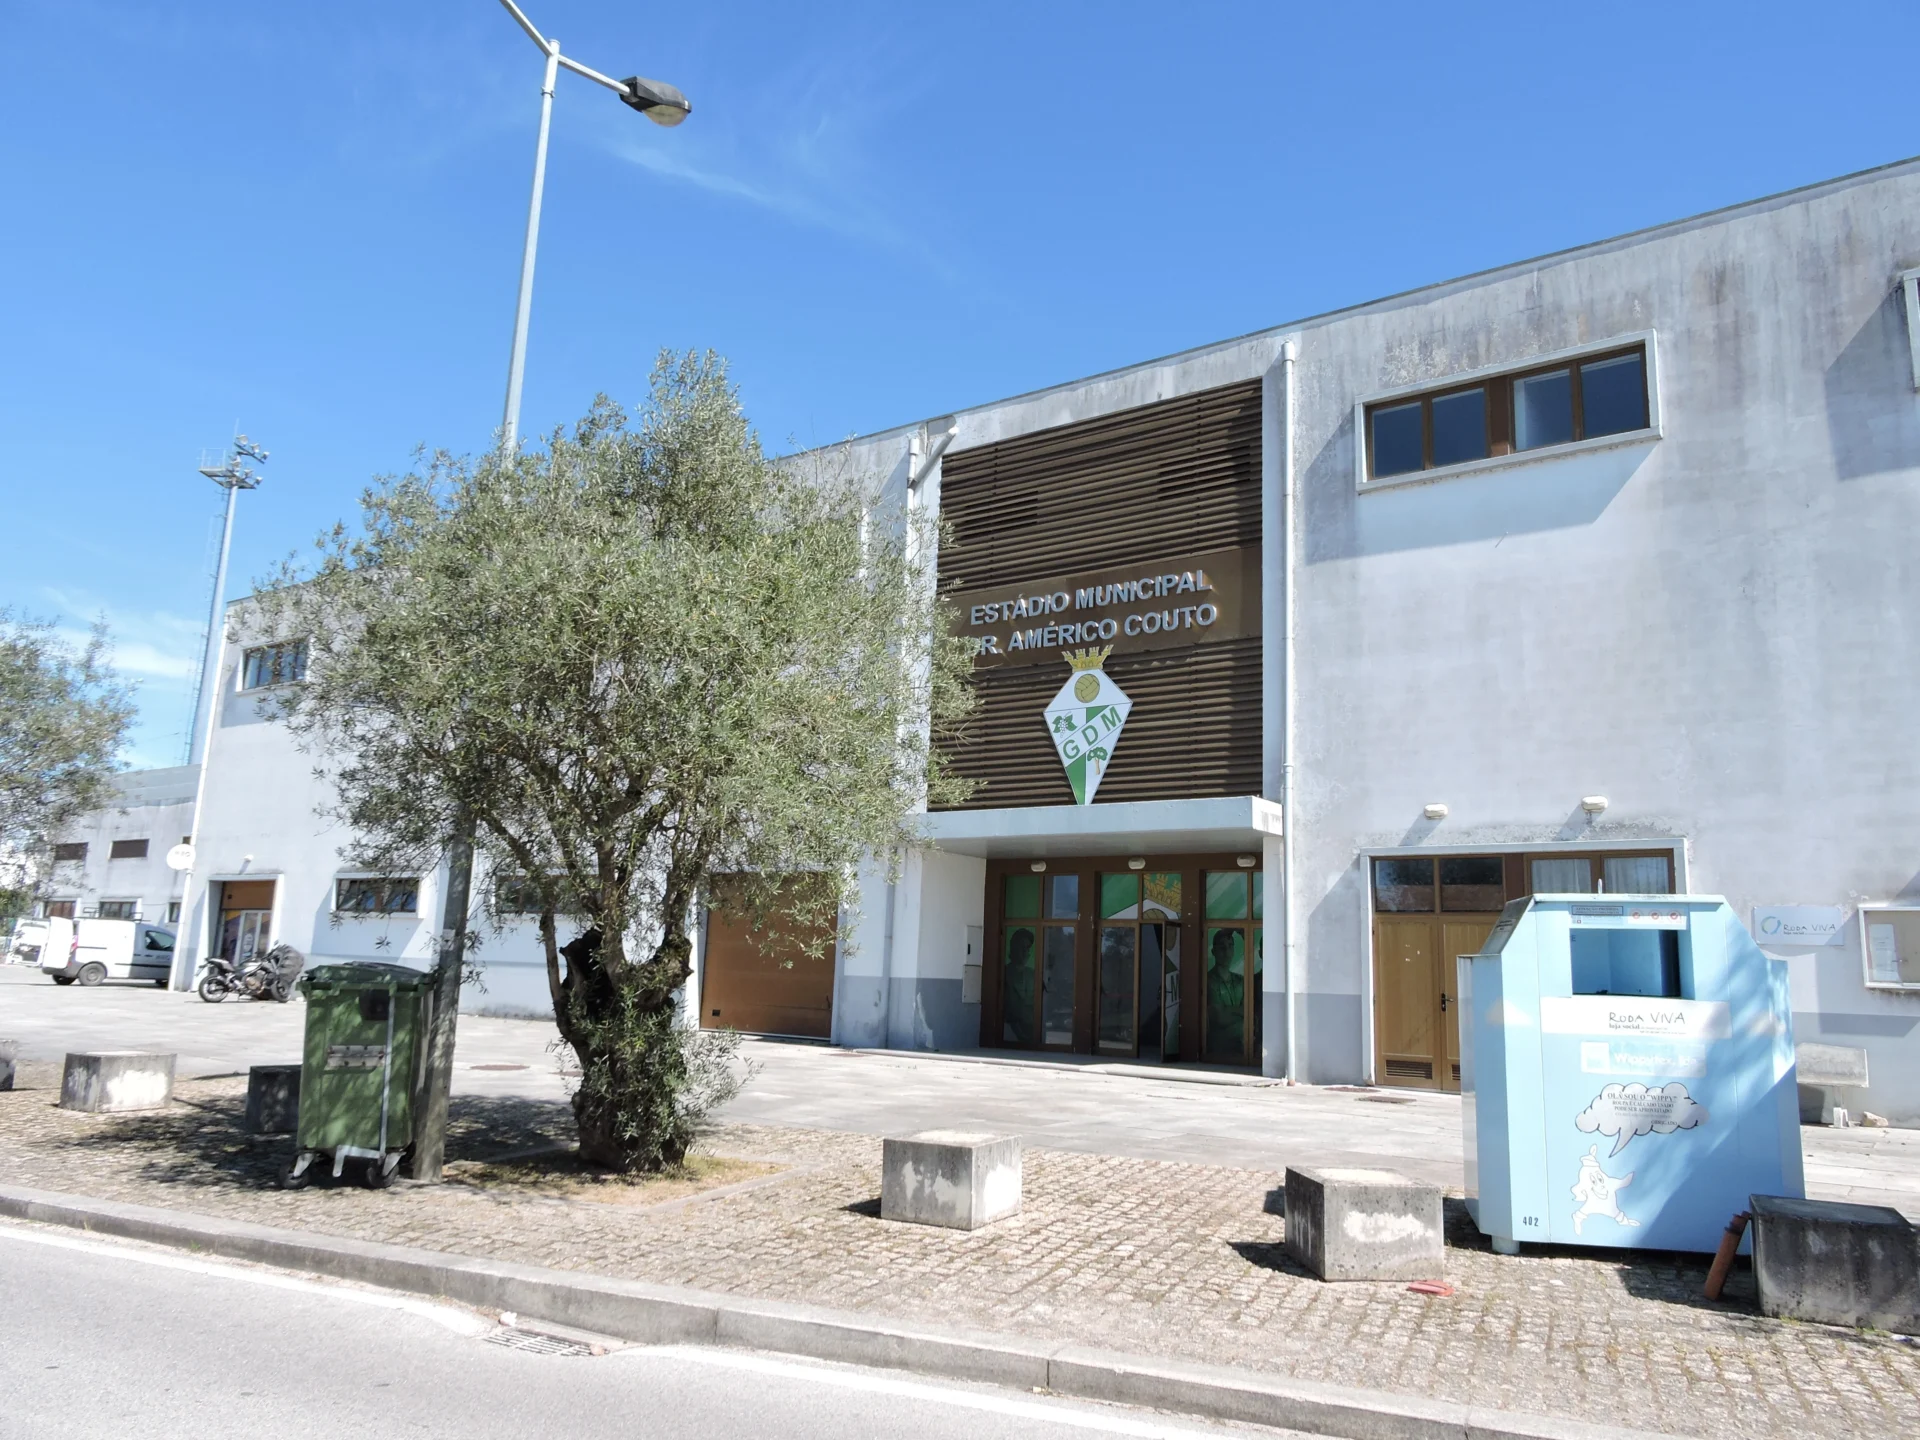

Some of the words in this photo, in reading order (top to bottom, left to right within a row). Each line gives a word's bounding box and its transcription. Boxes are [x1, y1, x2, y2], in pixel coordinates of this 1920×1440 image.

[970, 591, 1069, 626] ESTÁDIO
[1075, 569, 1213, 610] MUNICIPAL
[1008, 618, 1118, 651] AMÉRICO
[1124, 603, 1217, 636] COUTO
[1609, 1012, 1644, 1022] RODA
[1650, 1012, 1685, 1024] VIVA
[1523, 1216, 1539, 1227] 402
